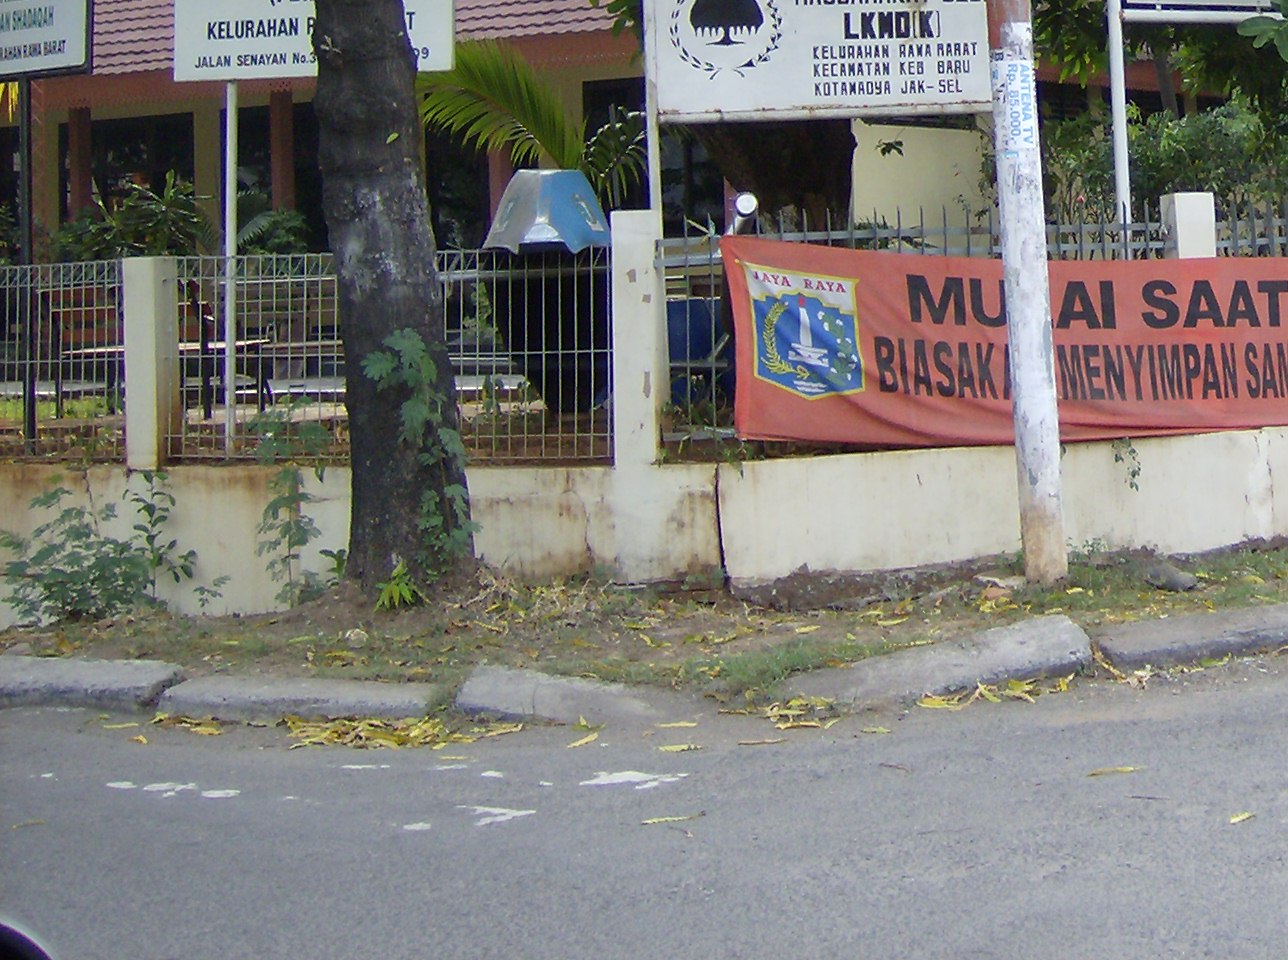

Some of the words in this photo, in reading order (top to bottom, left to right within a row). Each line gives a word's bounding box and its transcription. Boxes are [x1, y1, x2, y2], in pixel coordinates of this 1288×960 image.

[12, 6, 54, 31] SHADAQAH
[207, 17, 299, 41] KELURAHAN
[23, 42, 43, 59] RAWA
[44, 40, 67, 56] BARAT
[194, 55, 232, 69] JALAN
[236, 52, 287, 67] SENAYAN
[813, 44, 890, 60] KELURAHAN
[899, 44, 933, 58] RAWA
[813, 62, 890, 78] KECAMATAN
[899, 61, 925, 76] KEB
[937, 60, 971, 75] BARU
[1007, 63, 1019, 85] Rp.
[814, 80, 891, 97] KOTAMADYA
[938, 78, 963, 94] SEL
[1020, 64, 1032, 122] ANTENA
[1023, 125, 1034, 144] TV
[752, 270, 793, 289] JAYA
[803, 279, 847, 294] RAYA
[905, 274, 1116, 330] MUAI
[1057, 342, 1239, 401] MENYIMPAN
